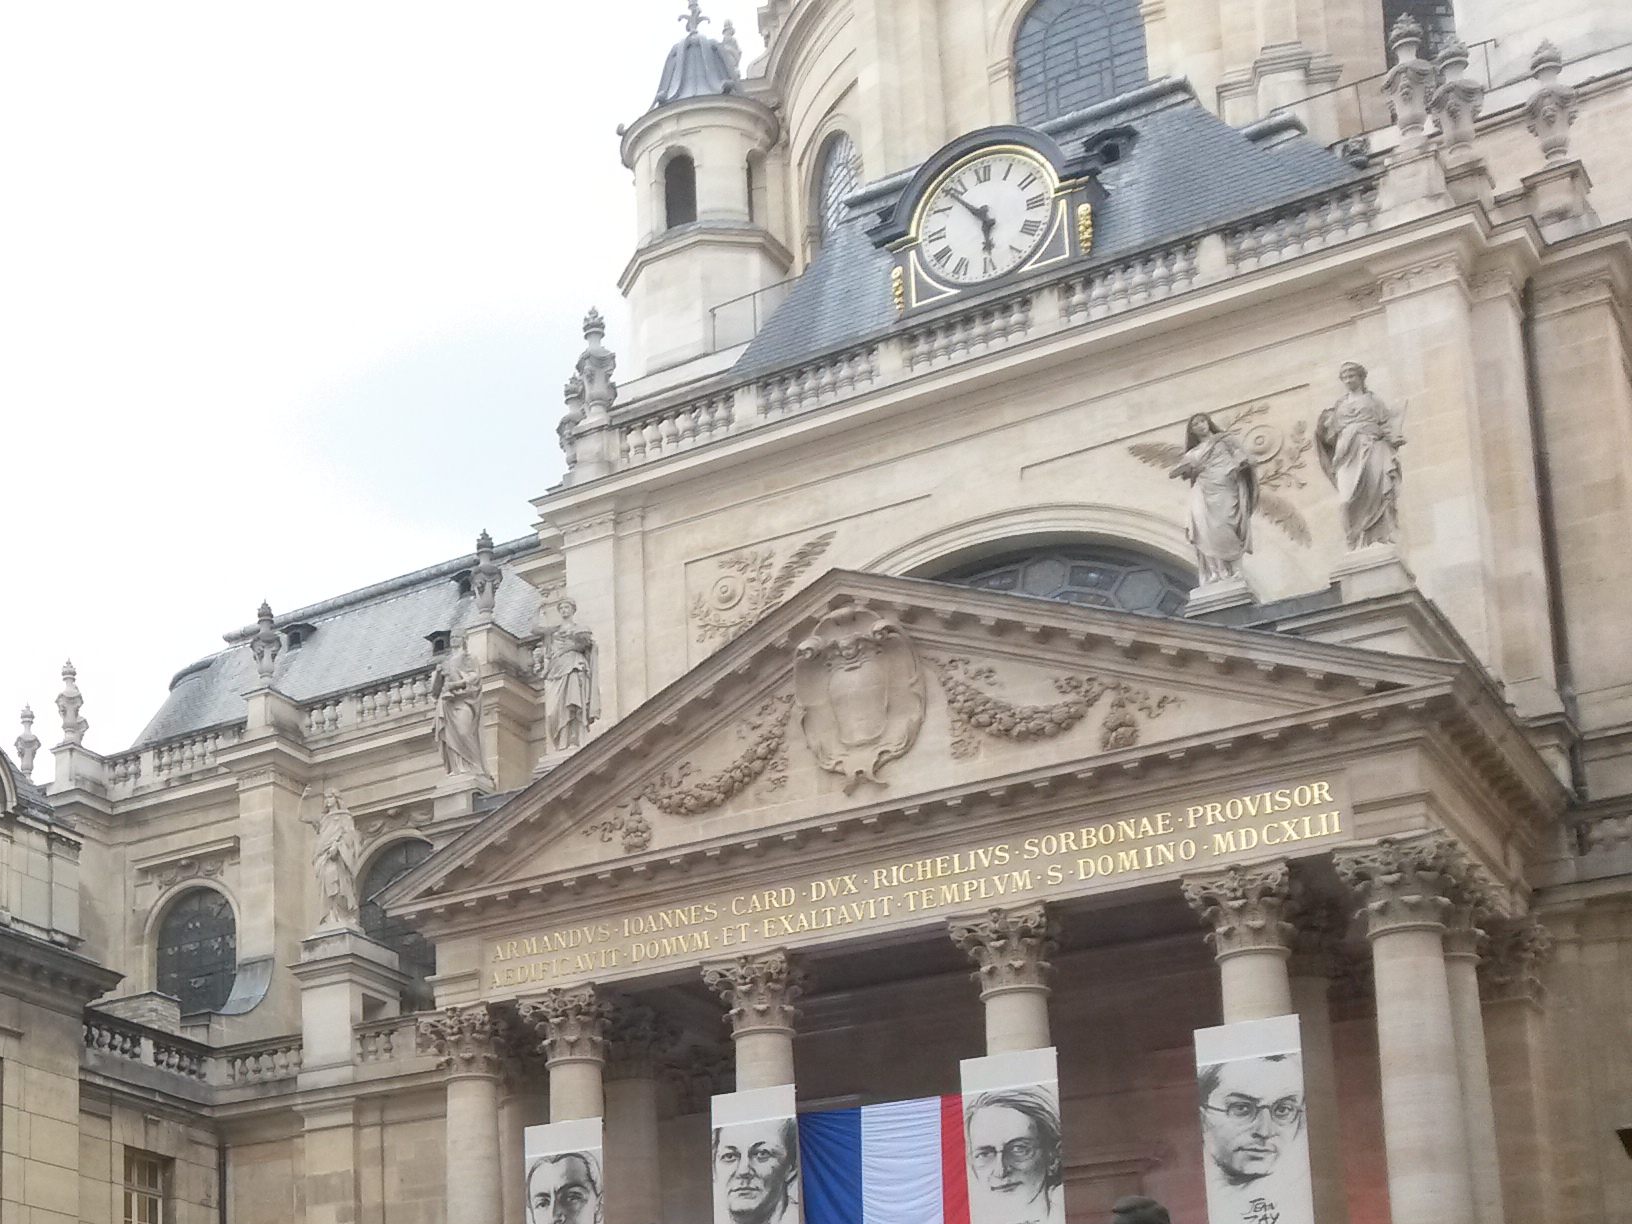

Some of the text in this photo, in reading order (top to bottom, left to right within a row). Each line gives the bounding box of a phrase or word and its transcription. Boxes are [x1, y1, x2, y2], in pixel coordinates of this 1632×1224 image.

[490, 810, 1342, 989] AEDIFICAVIT DOMVM ET EXALTAVIT TEMPLVM S DOMINO MDCXLII
[491, 780, 1334, 963] ARMANDVS IOANNES CARD DVX RICHELIVS SORBONAE PROVISOR
[1241, 1197, 1276, 1215] JEAN
